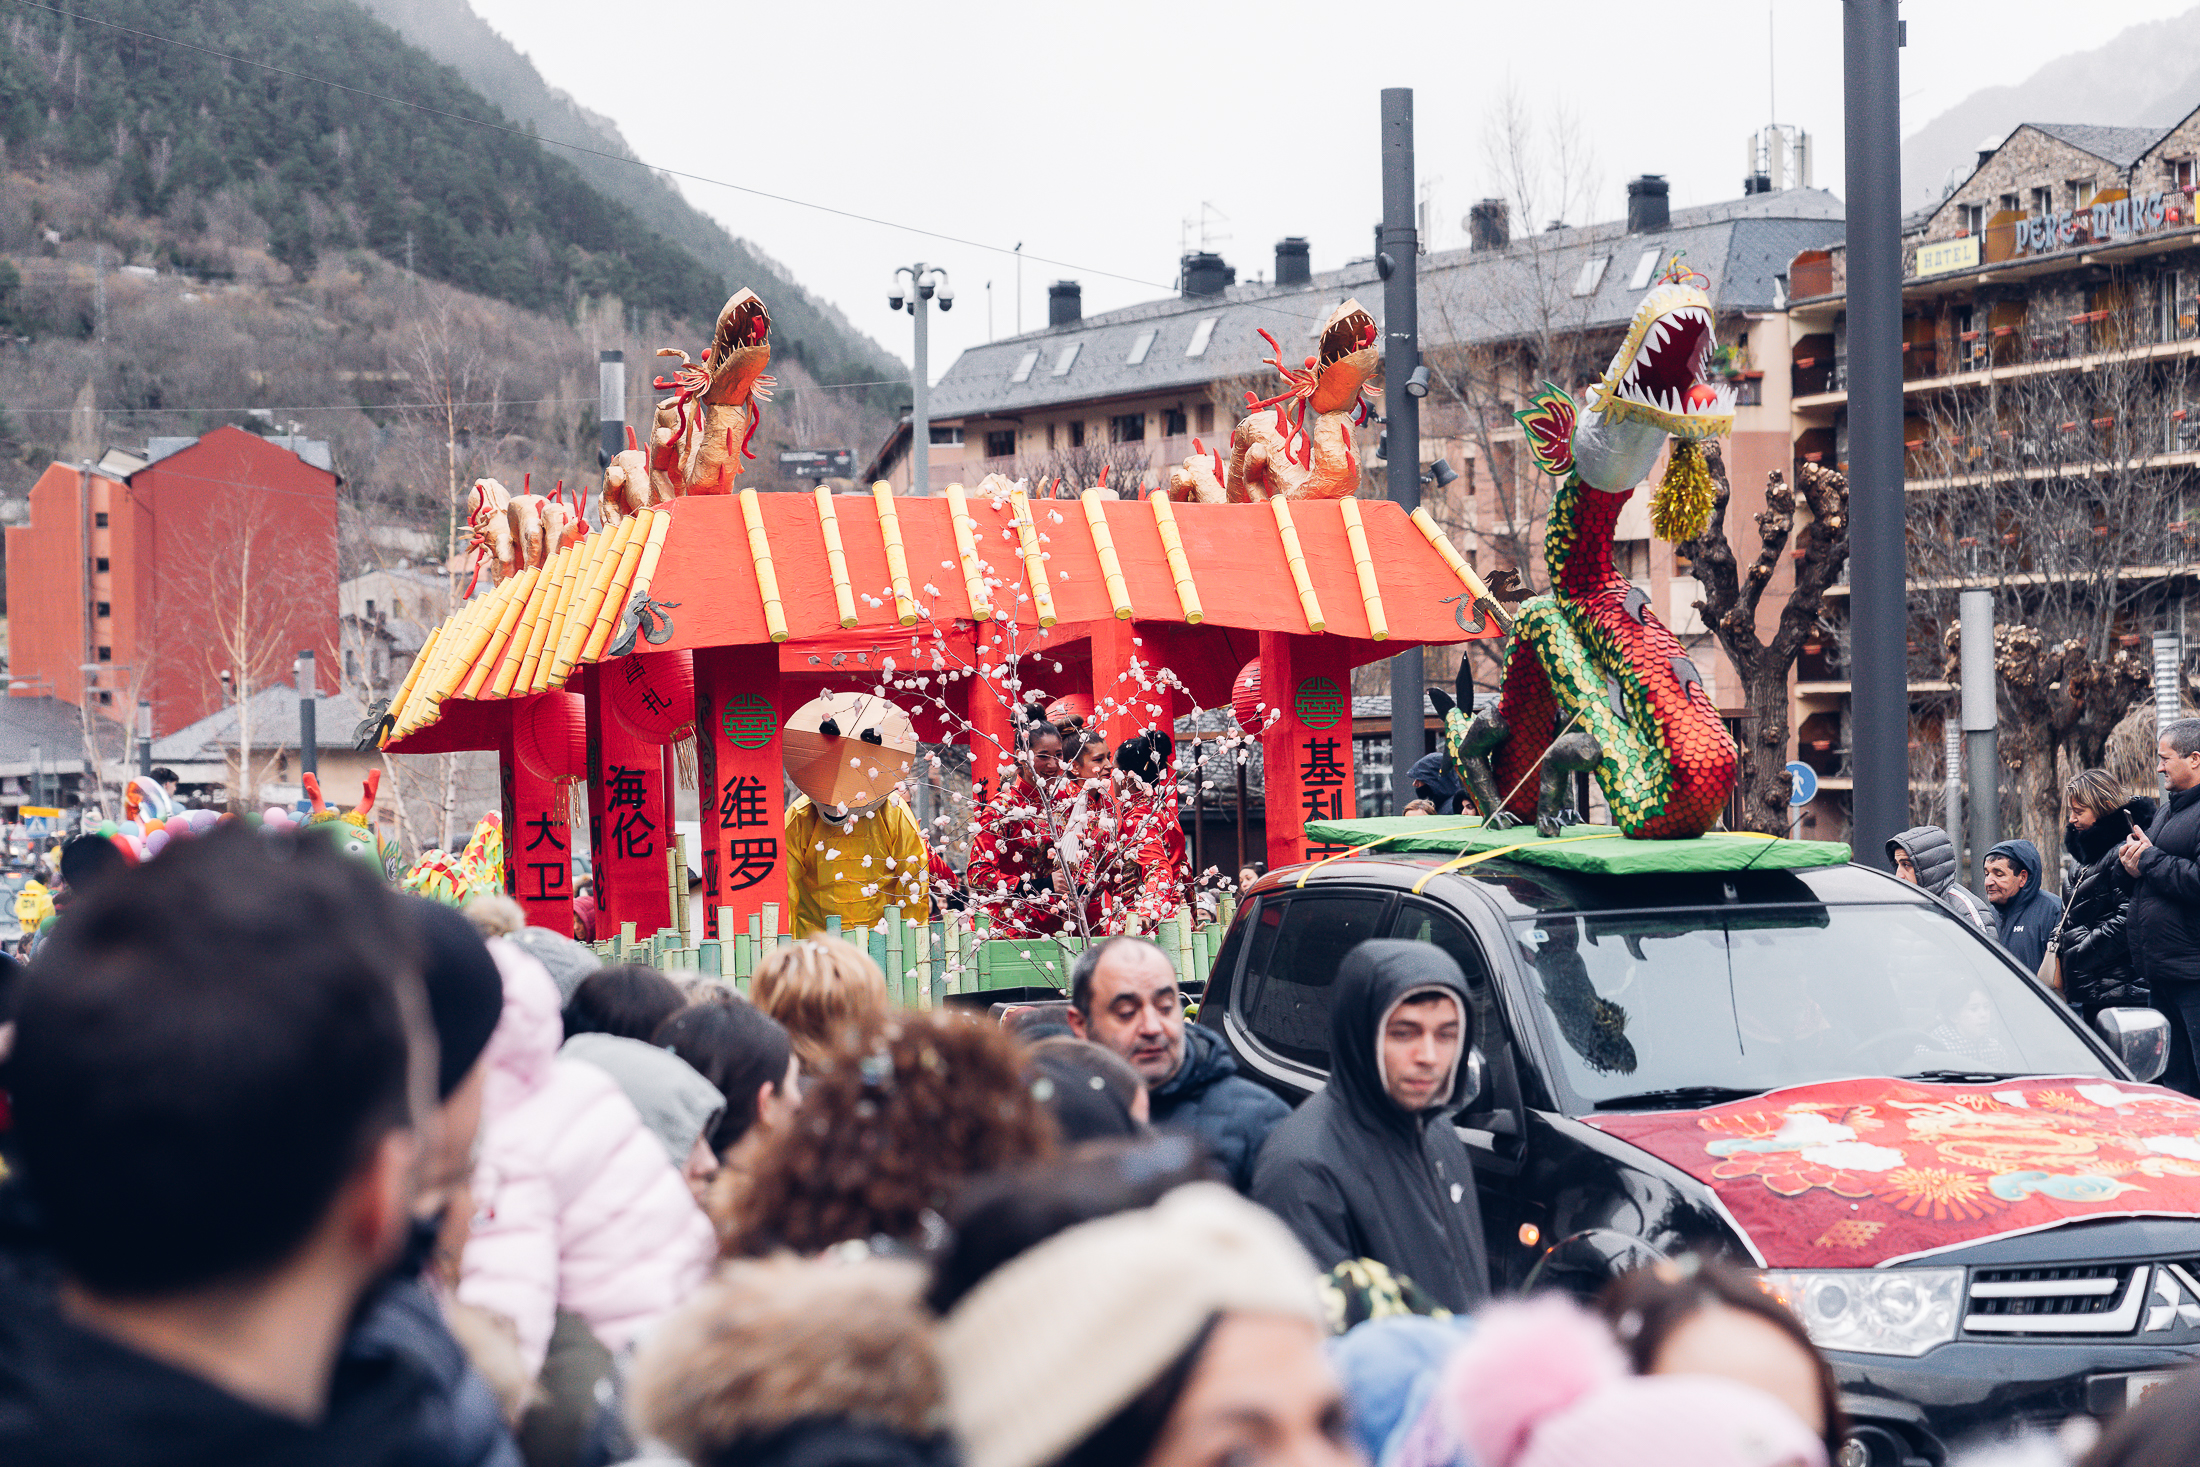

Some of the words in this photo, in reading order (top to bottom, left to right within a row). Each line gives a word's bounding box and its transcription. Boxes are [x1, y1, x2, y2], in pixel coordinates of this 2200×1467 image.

[1924, 245, 1971, 269] HOTEL
[2015, 210, 2075, 253] PERE
[604, 764, 656, 859] 海伦
[719, 775, 778, 891] 维罗
[526, 812, 570, 900] 大卫
